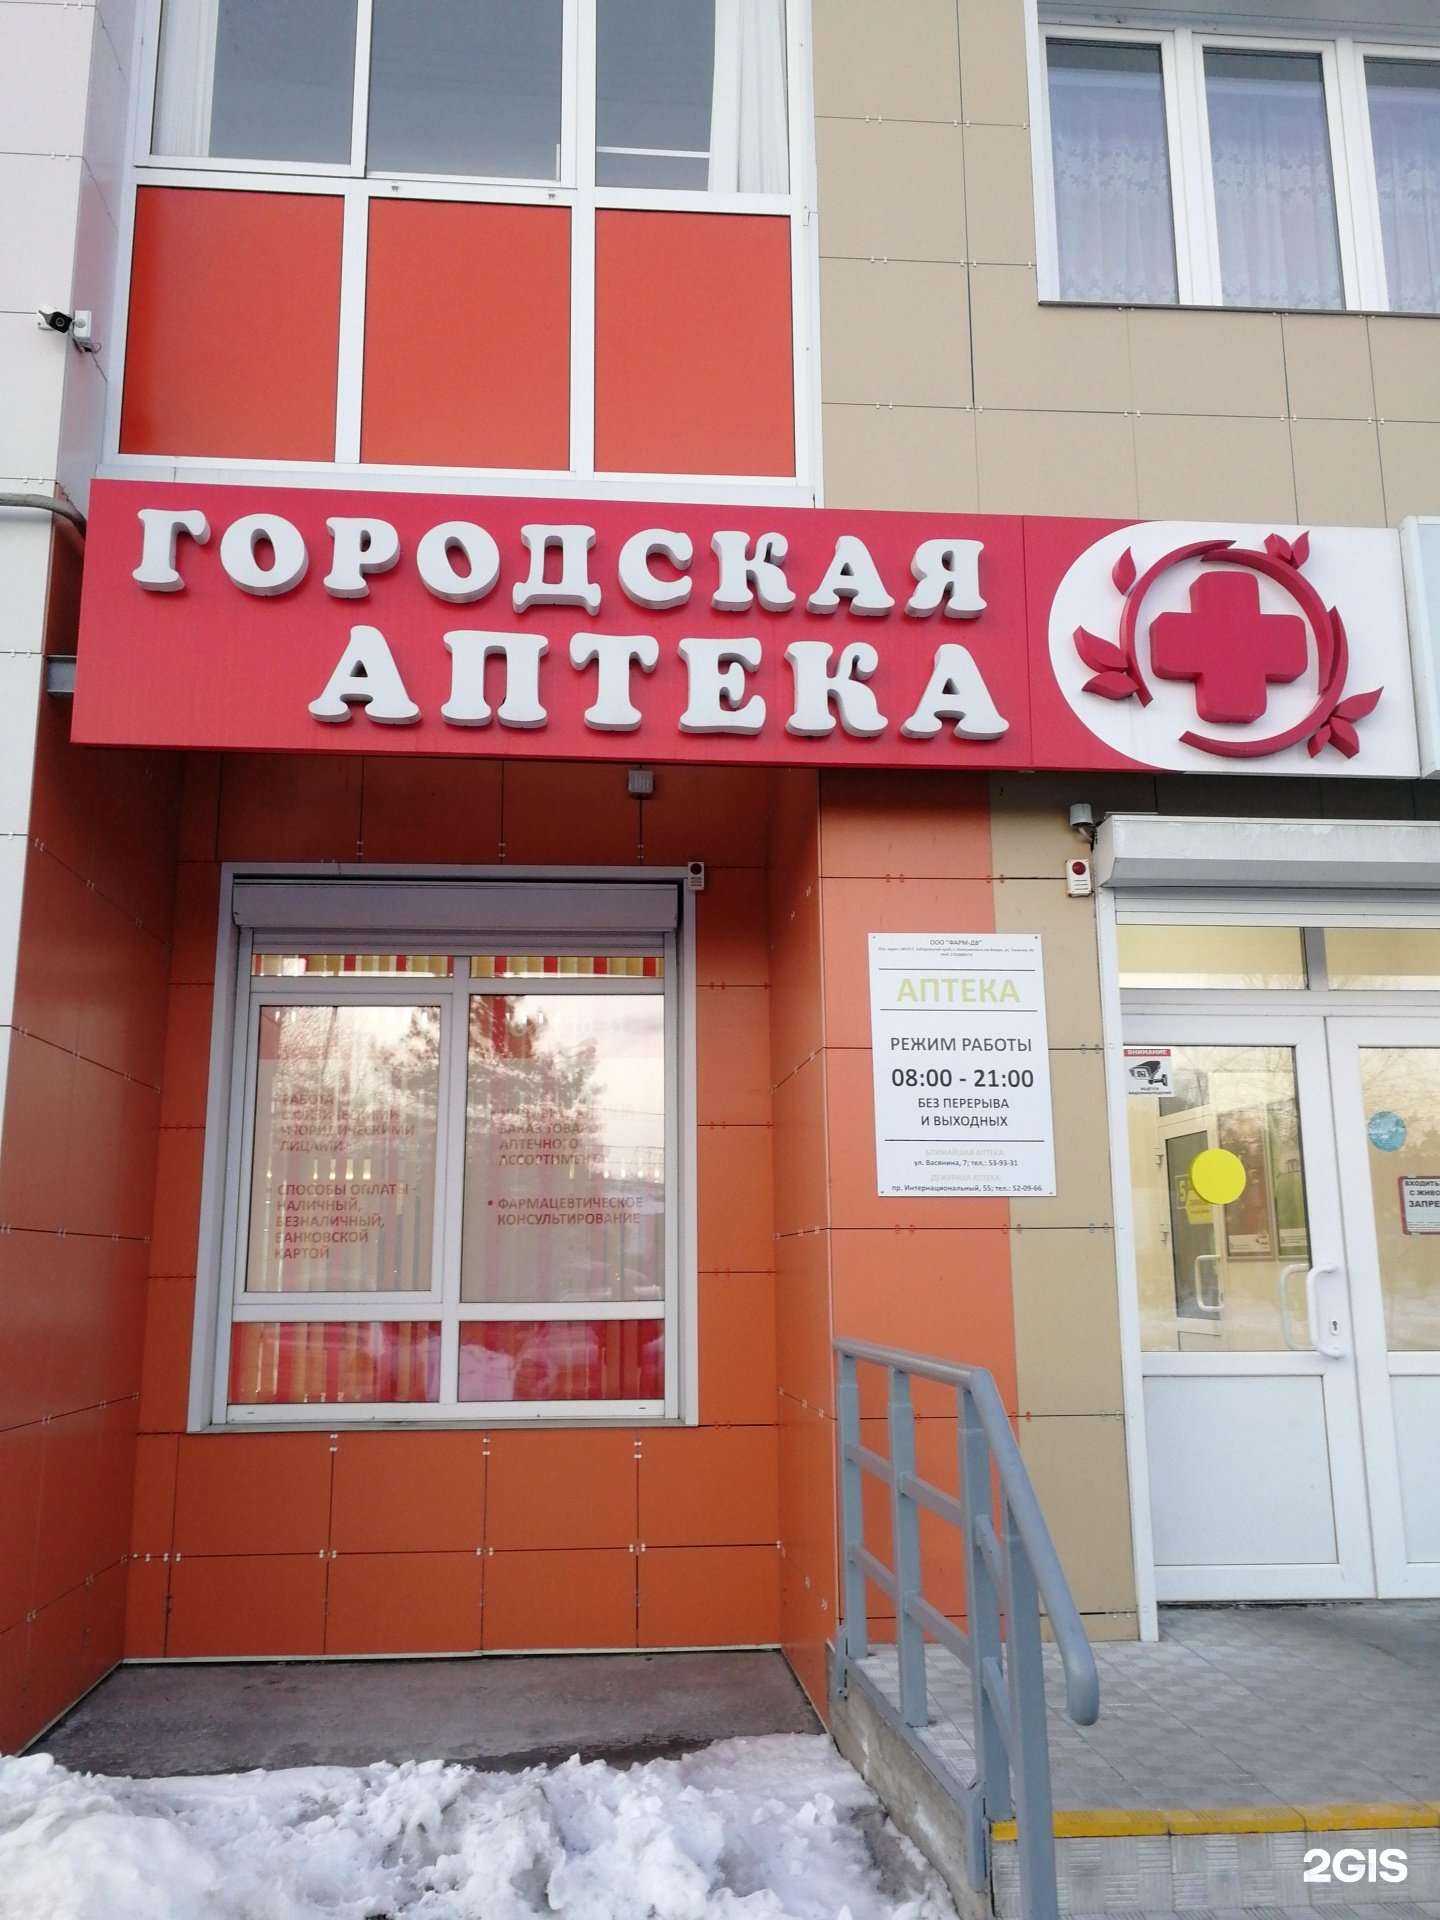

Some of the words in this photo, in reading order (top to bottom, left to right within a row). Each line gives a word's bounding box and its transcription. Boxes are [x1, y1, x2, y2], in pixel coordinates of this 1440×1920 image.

[131, 508, 986, 620] ГОРОДСКАЯ
[308, 624, 1010, 742] АПТЕКА
[897, 978, 1021, 1003] АПТЕКА
[890, 1037, 956, 1051] РЕЖИМ
[962, 1038, 1032, 1051] РАБОТЫ
[891, 1068, 952, 1087] 08:00
[974, 1069, 1034, 1088] 21:00
[918, 1098, 940, 1109] БЕЗ
[943, 1098, 1010, 1109] ПЕРЕРЫВА
[921, 1116, 930, 1126] И
[933, 1116, 1008, 1128] ВЫХОДНЫХ
[278, 1184, 346, 1195] СПОСОБЫ
[497, 1197, 643, 1210] ФАРМАЦЕВТИЧЕСКОЕ
[1408, 1200, 1440, 1208] ЗАПРЕ
[275, 1213, 385, 1229] БЕЗНАЛИЧНЫЙ,
[497, 1213, 641, 1226] КОНСУЛЬТИРОВАНИЕ
[275, 1229, 369, 1243] БАНКОВСКОЙ
[274, 1244, 330, 1259] КАРТОЙ
